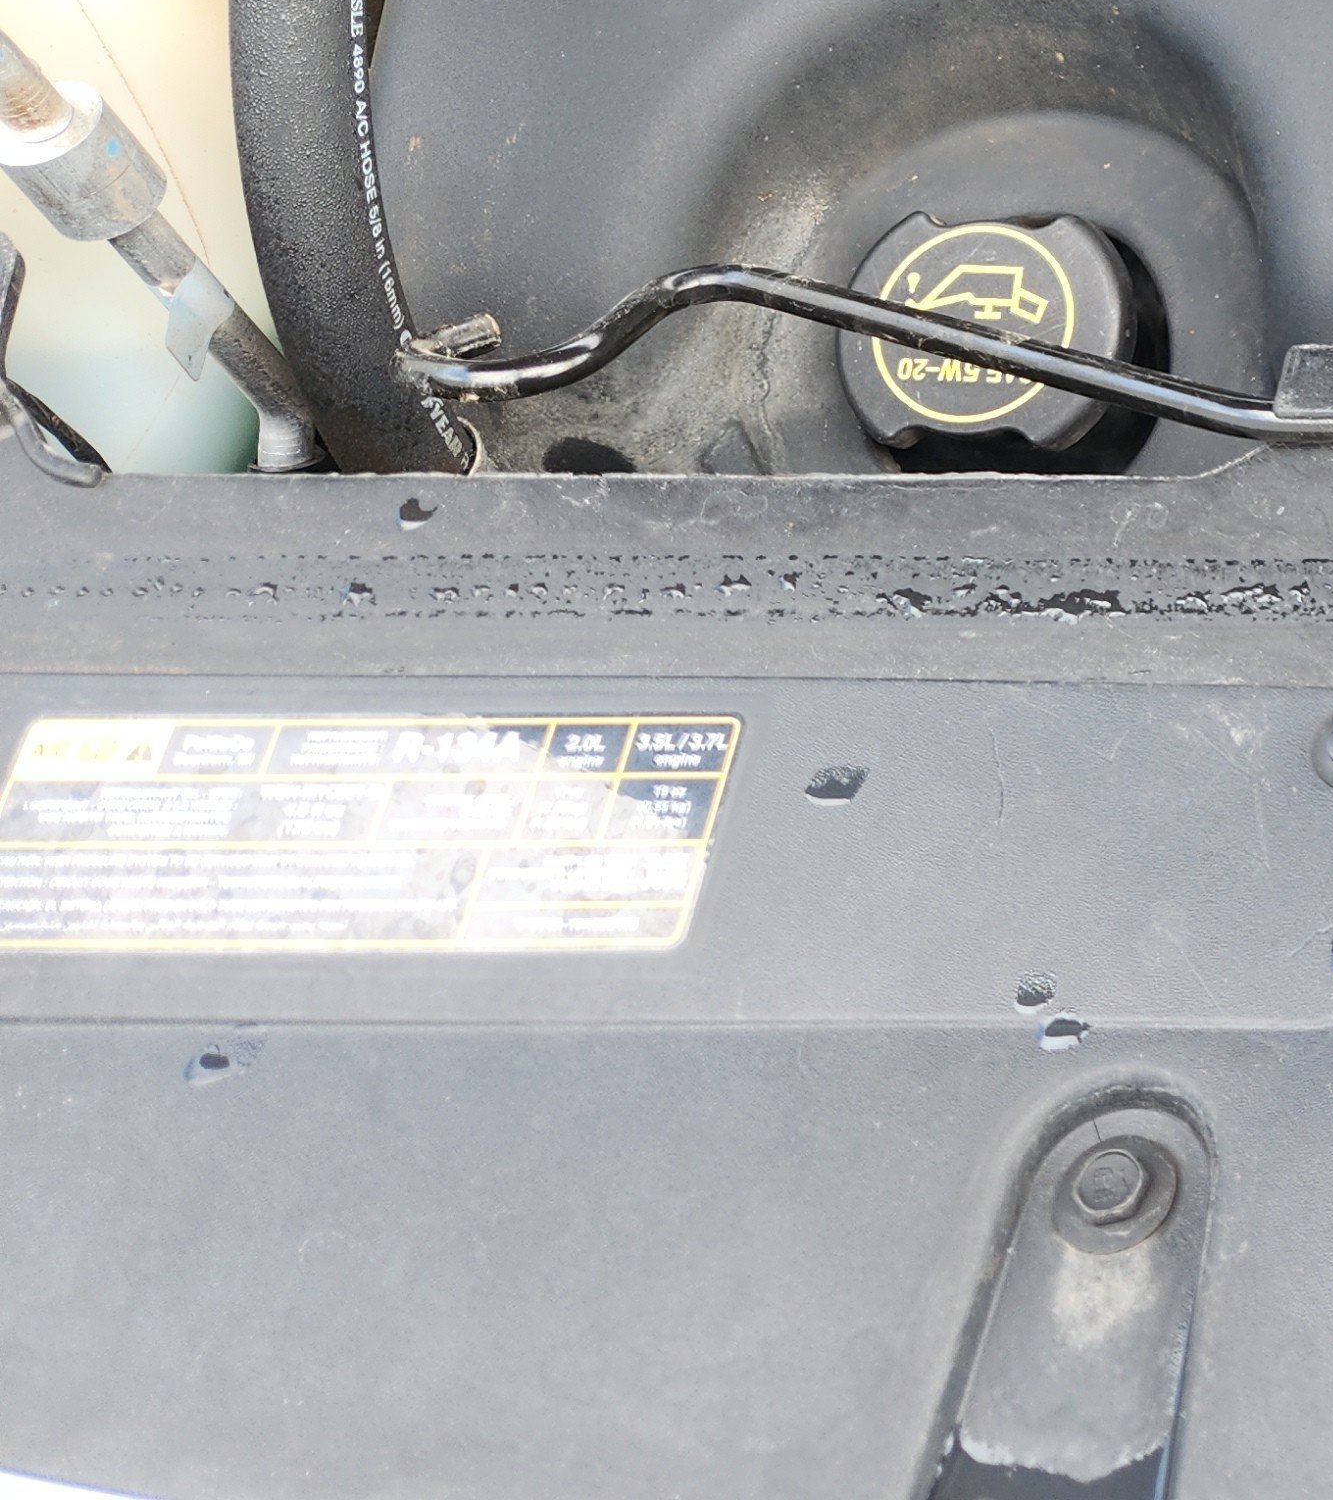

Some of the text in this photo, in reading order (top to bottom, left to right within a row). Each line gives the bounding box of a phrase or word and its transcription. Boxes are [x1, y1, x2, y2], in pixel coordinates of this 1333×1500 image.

[351, 43, 365, 93] 4890
[354, 99, 368, 136] A/C
[358, 139, 377, 203] HOSE
[368, 204, 381, 237] 5/8
[374, 238, 386, 259] in
[377, 260, 406, 330] (16mm)
[897, 358, 981, 383] 5W-20
[564, 733, 606, 753] 2.0L
[653, 753, 702, 768] engine
